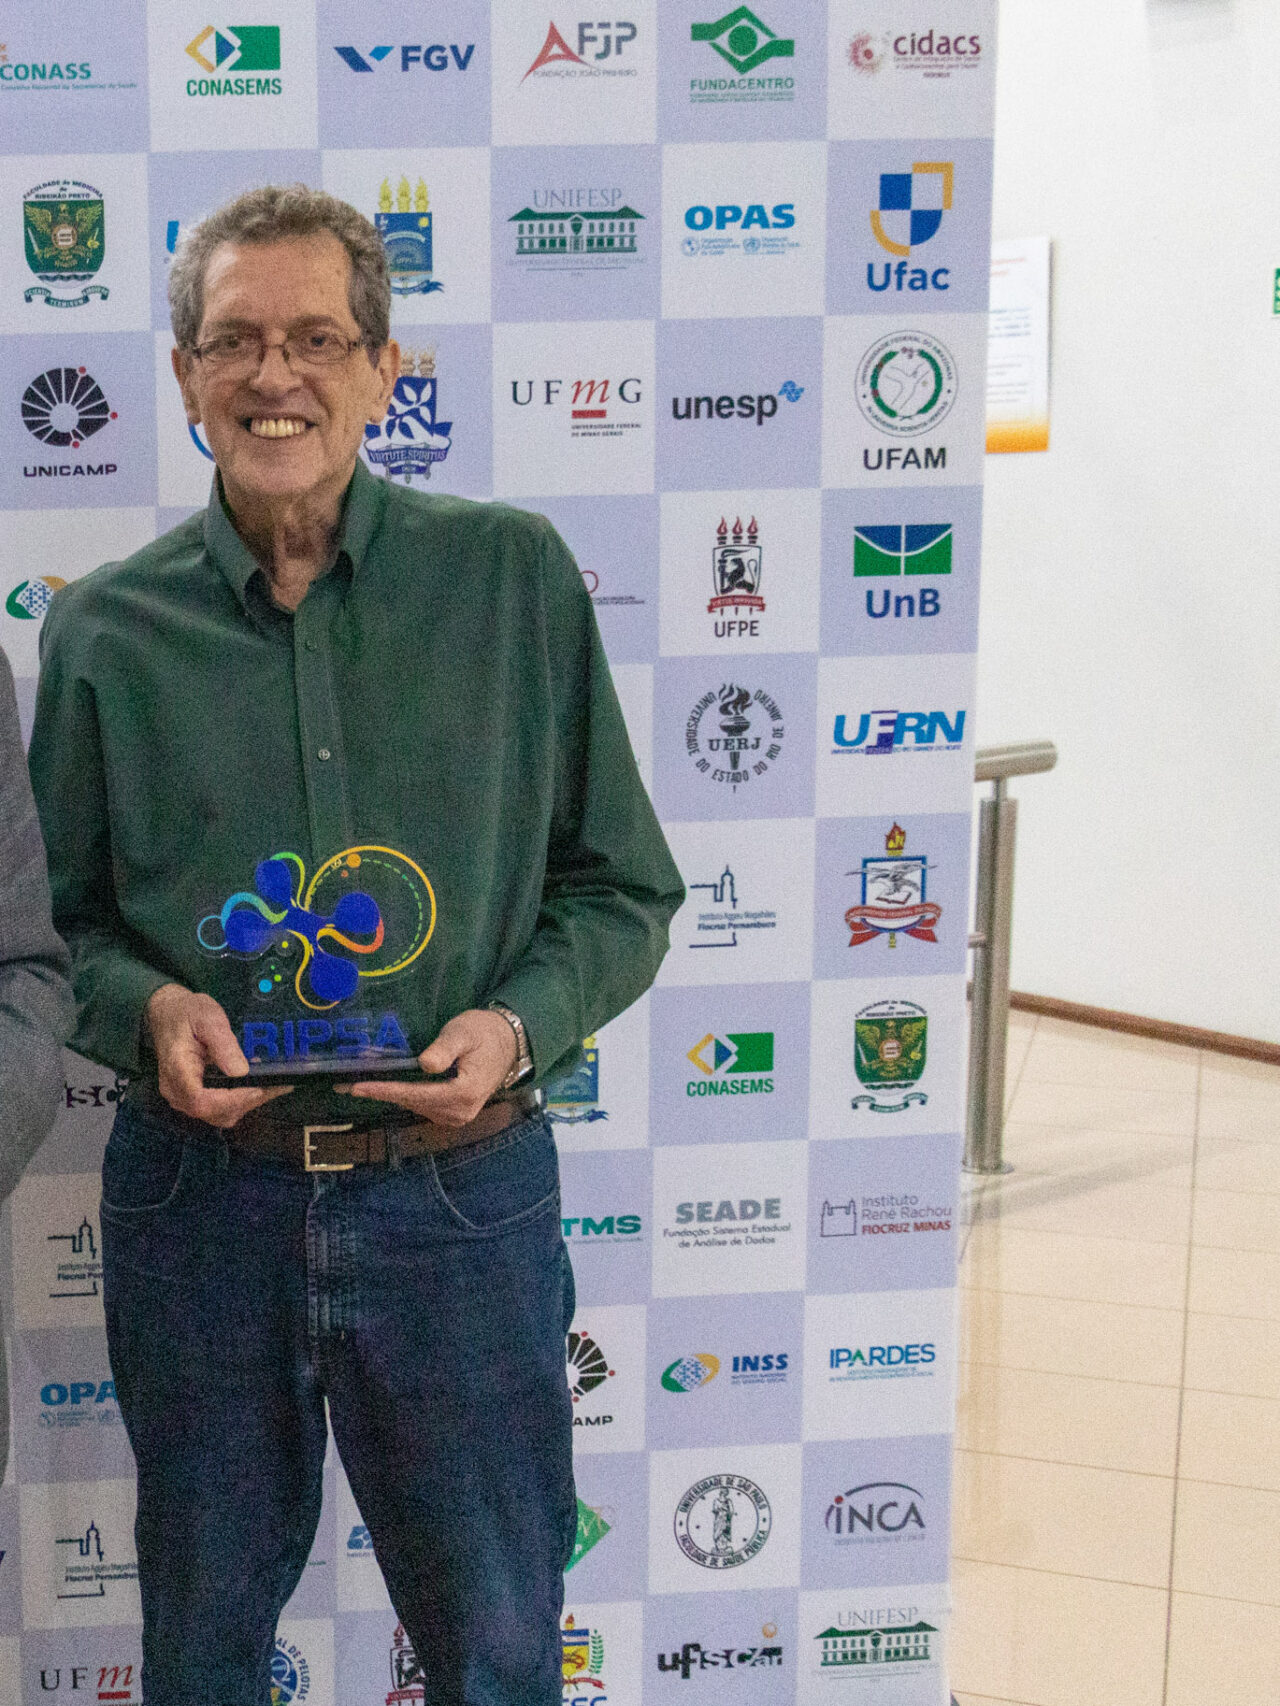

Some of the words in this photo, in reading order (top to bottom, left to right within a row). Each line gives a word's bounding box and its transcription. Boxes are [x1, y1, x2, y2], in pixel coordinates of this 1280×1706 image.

[578, 22, 637, 61] FJP
[893, 29, 980, 55] cidacs
[401, 44, 475, 72] FGV
[0, 62, 92, 81] CONASS
[186, 78, 282, 96] CONASEMS
[690, 77, 795, 91] FUNDACENTRO
[533, 188, 622, 208] UNIFESP
[684, 203, 795, 231] OPAS
[866, 262, 949, 292] Ufac
[672, 388, 779, 427] unesp
[863, 447, 946, 470] UFAM
[23, 463, 118, 478] UNICAMP
[865, 588, 941, 619] UnB
[714, 620, 760, 638] UFPE
[686, 692, 717, 757] UNIVERSIDADE
[833, 710, 966, 748] UFRN
[708, 737, 762, 751] UERJ
[243, 1012, 410, 1059] RIPSA
[686, 1078, 774, 1098] CONASEMS
[675, 1198, 781, 1224] SEADE
[862, 1195, 919, 1207] Instituto
[862, 1208, 897, 1220] René
[901, 1206, 952, 1219] Rachou
[663, 1227, 710, 1239] Fundação
[751, 1223, 791, 1234] Estadual
[862, 1222, 910, 1235] FIOCRUZ
[913, 1220, 951, 1232] MINAS
[732, 1353, 788, 1373] INSS
[830, 1344, 936, 1369] IPARDES
[40, 1381, 117, 1406] OPA
[837, 1607, 919, 1627] UNIFESP
